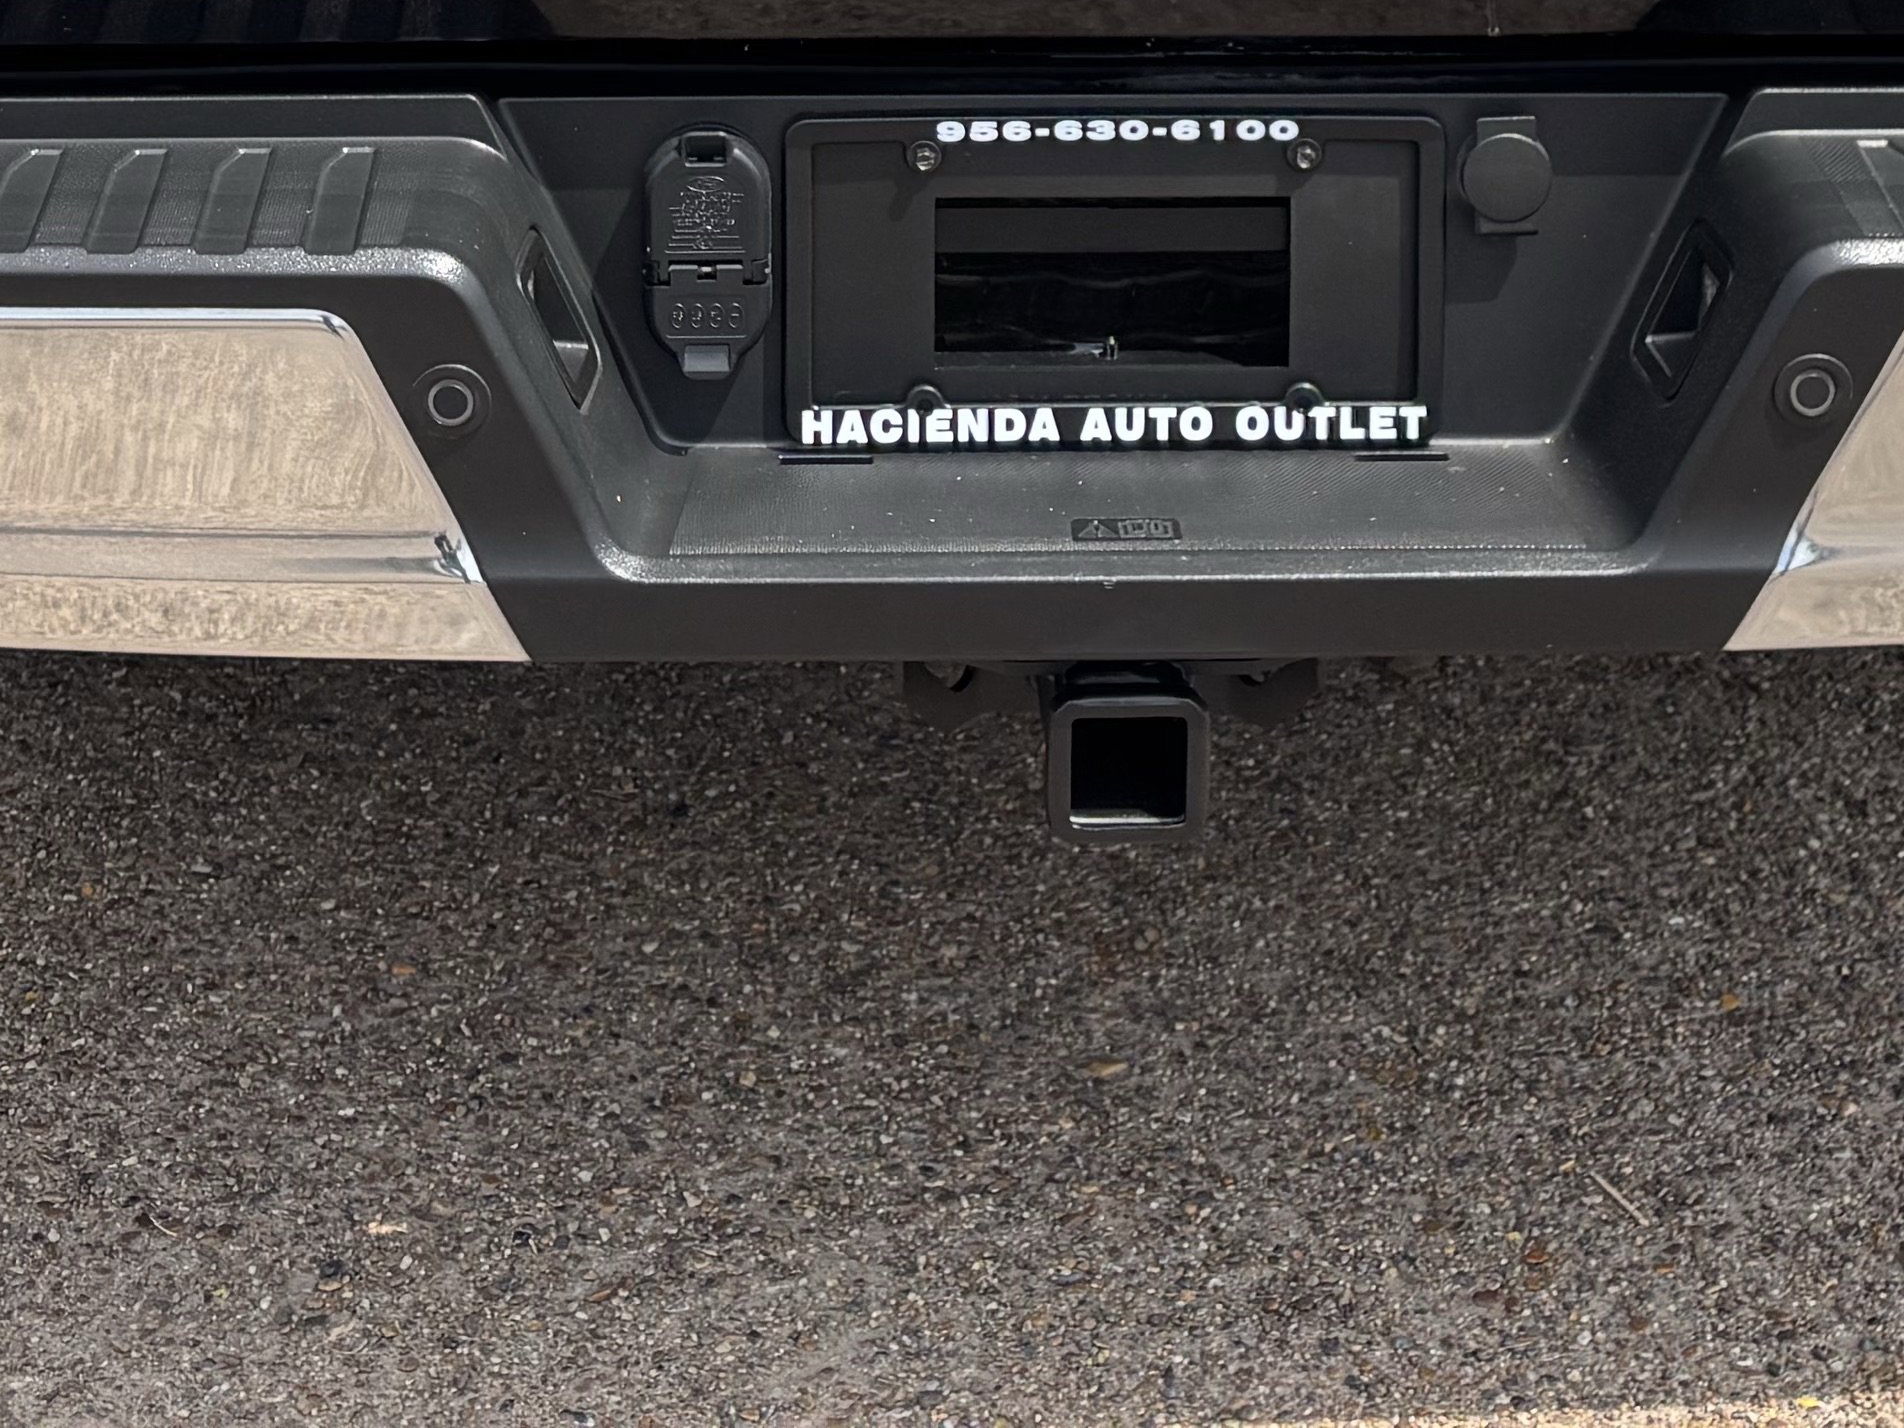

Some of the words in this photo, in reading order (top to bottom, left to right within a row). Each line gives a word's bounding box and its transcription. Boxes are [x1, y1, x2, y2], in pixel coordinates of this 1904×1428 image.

[936, 120, 1299, 142] 956-630-6100
[801, 407, 1061, 445] HACIENDA
[1080, 406, 1214, 443] AUTO
[1234, 406, 1428, 442] OUTLET
